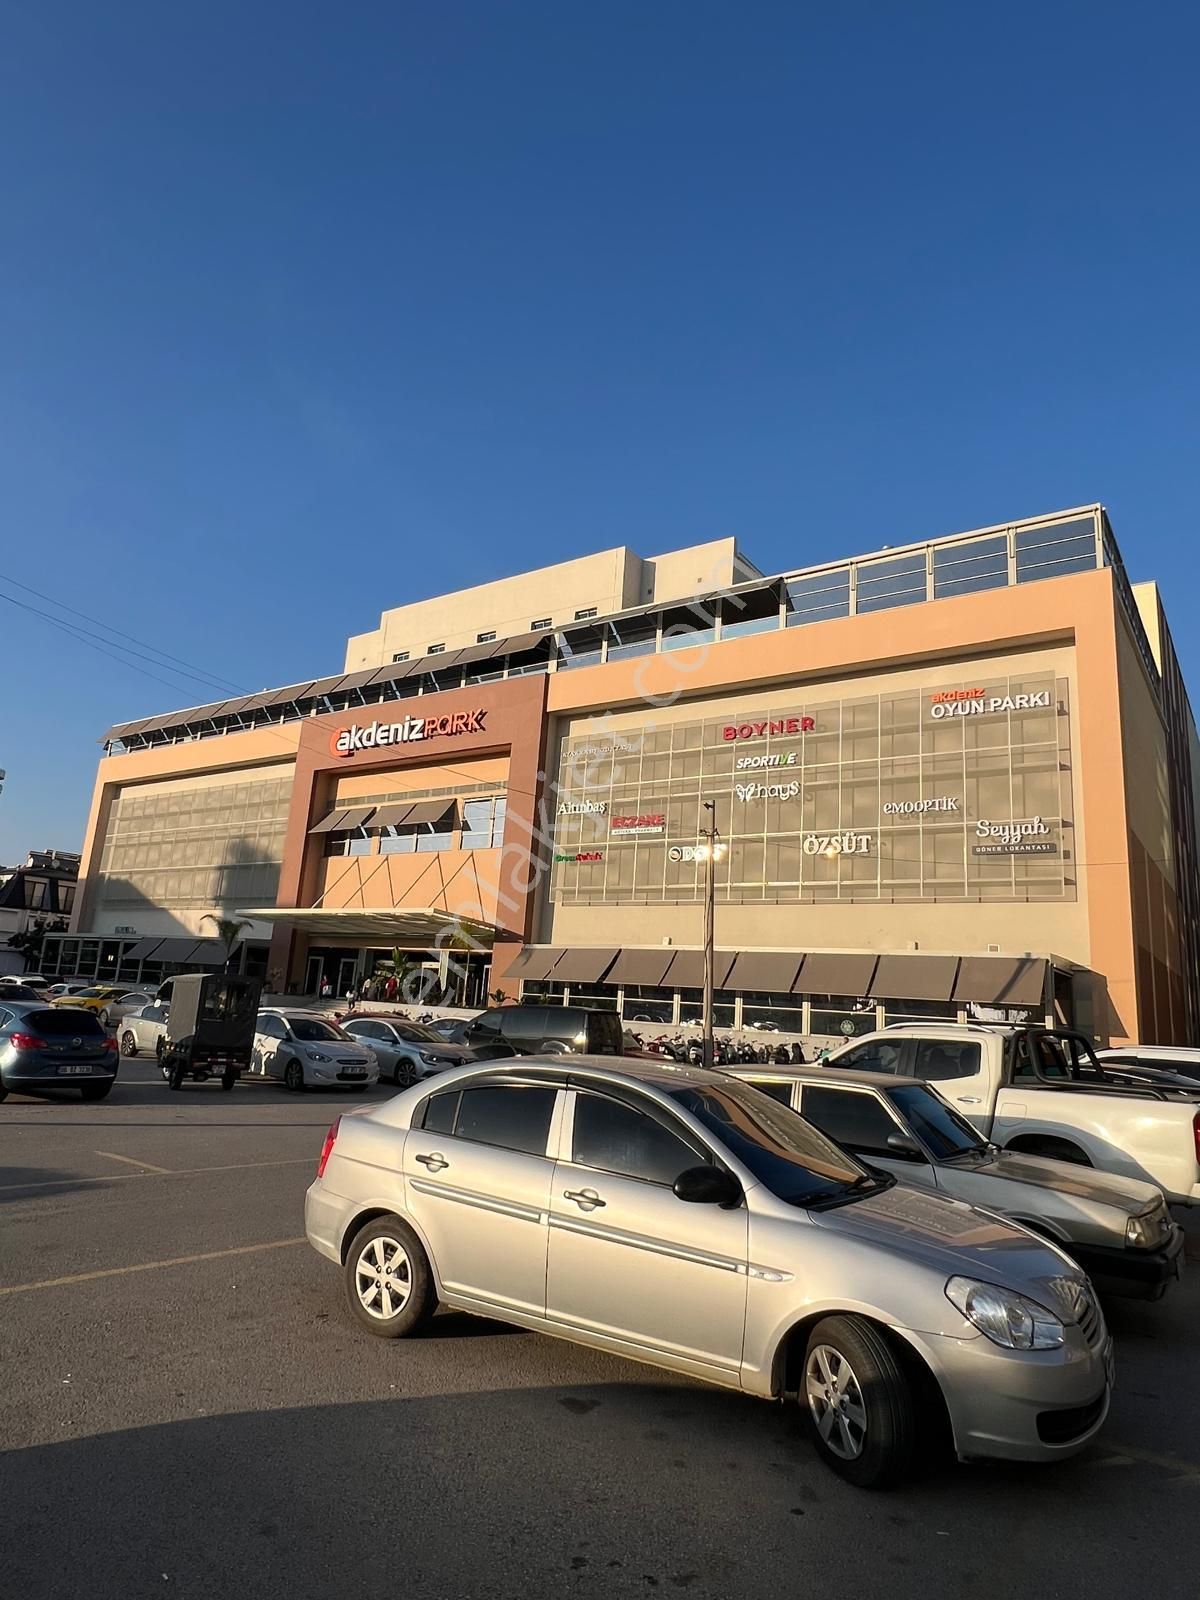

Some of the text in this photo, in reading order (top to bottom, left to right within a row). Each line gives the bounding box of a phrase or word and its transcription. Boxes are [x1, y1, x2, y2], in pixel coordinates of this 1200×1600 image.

[931, 688, 985, 703] akdeniz
[931, 691, 1051, 719] OYUN PARKI
[723, 716, 815, 741] BOYNER
[736, 752, 797, 769] SPORTIVE
[757, 780, 801, 801] hays
[975, 815, 1050, 844] Seyyah
[803, 832, 872, 855] ÖZSÜT
